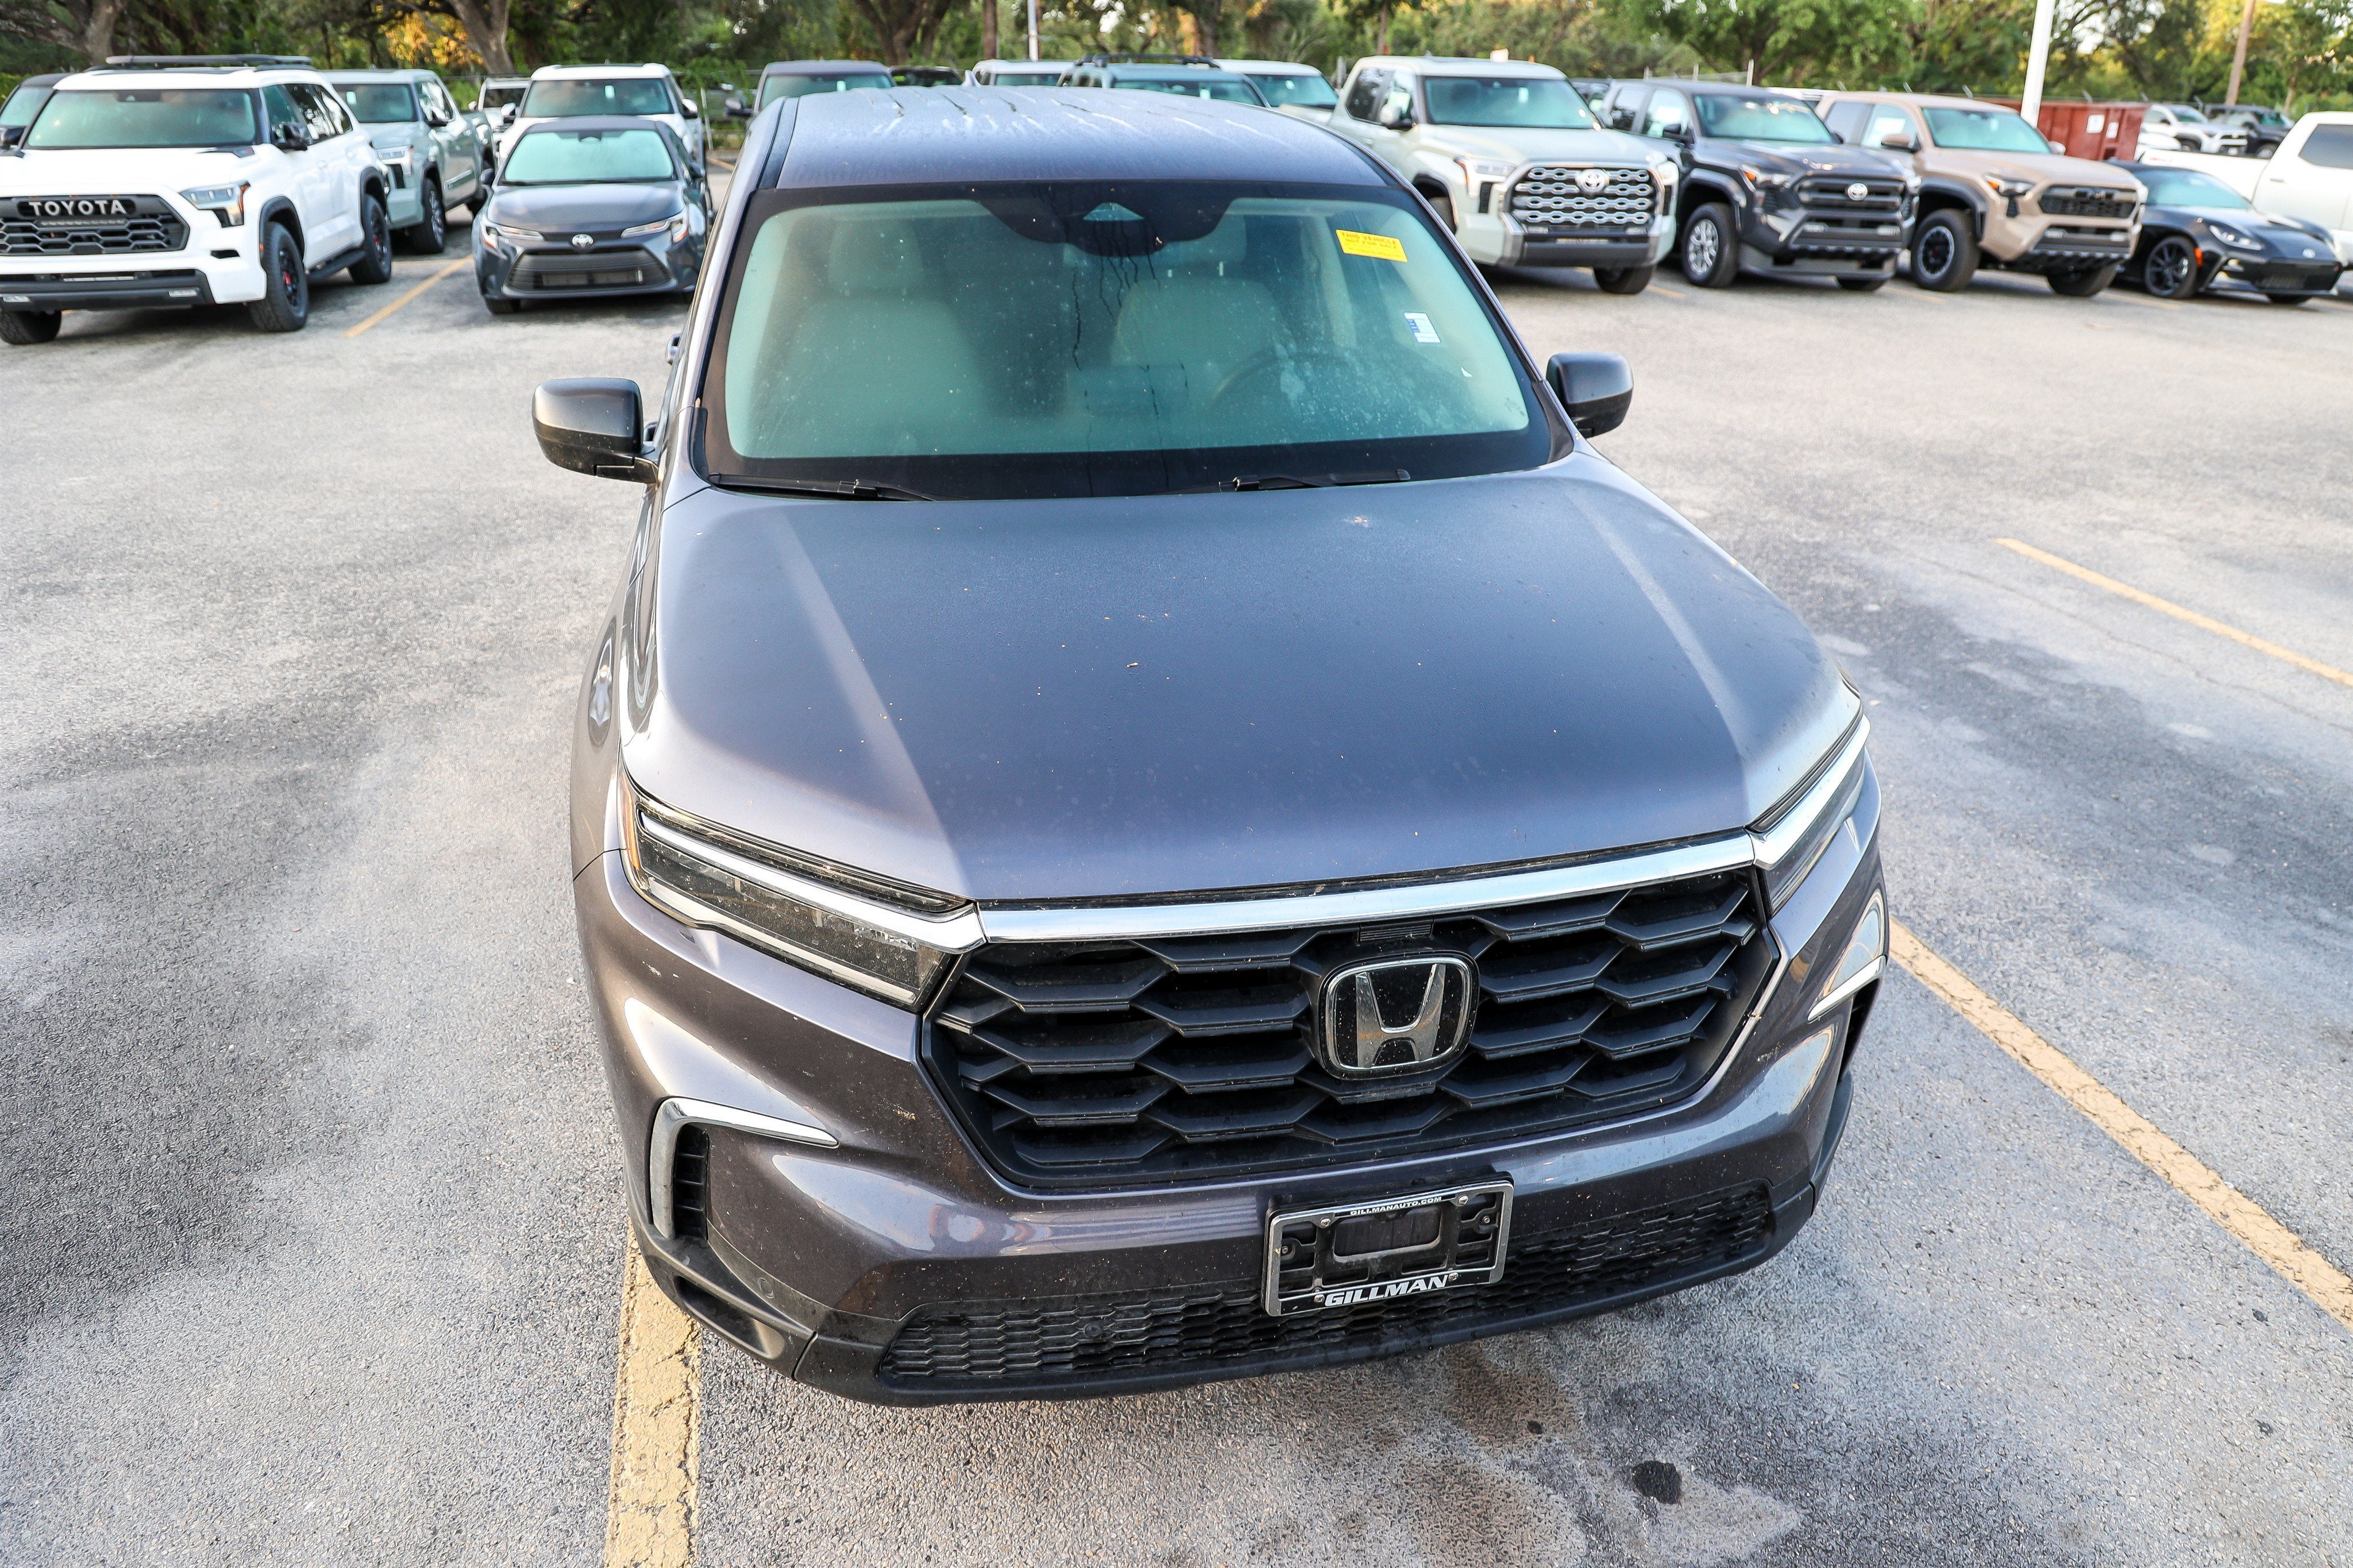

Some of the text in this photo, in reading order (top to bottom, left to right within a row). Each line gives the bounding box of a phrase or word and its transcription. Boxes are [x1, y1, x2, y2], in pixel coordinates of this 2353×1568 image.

[28, 199, 128, 217] TOYOTA
[1350, 1196, 1442, 1216] GILLMANAUTO.COM
[1325, 1275, 1448, 1307] GILLMAN
